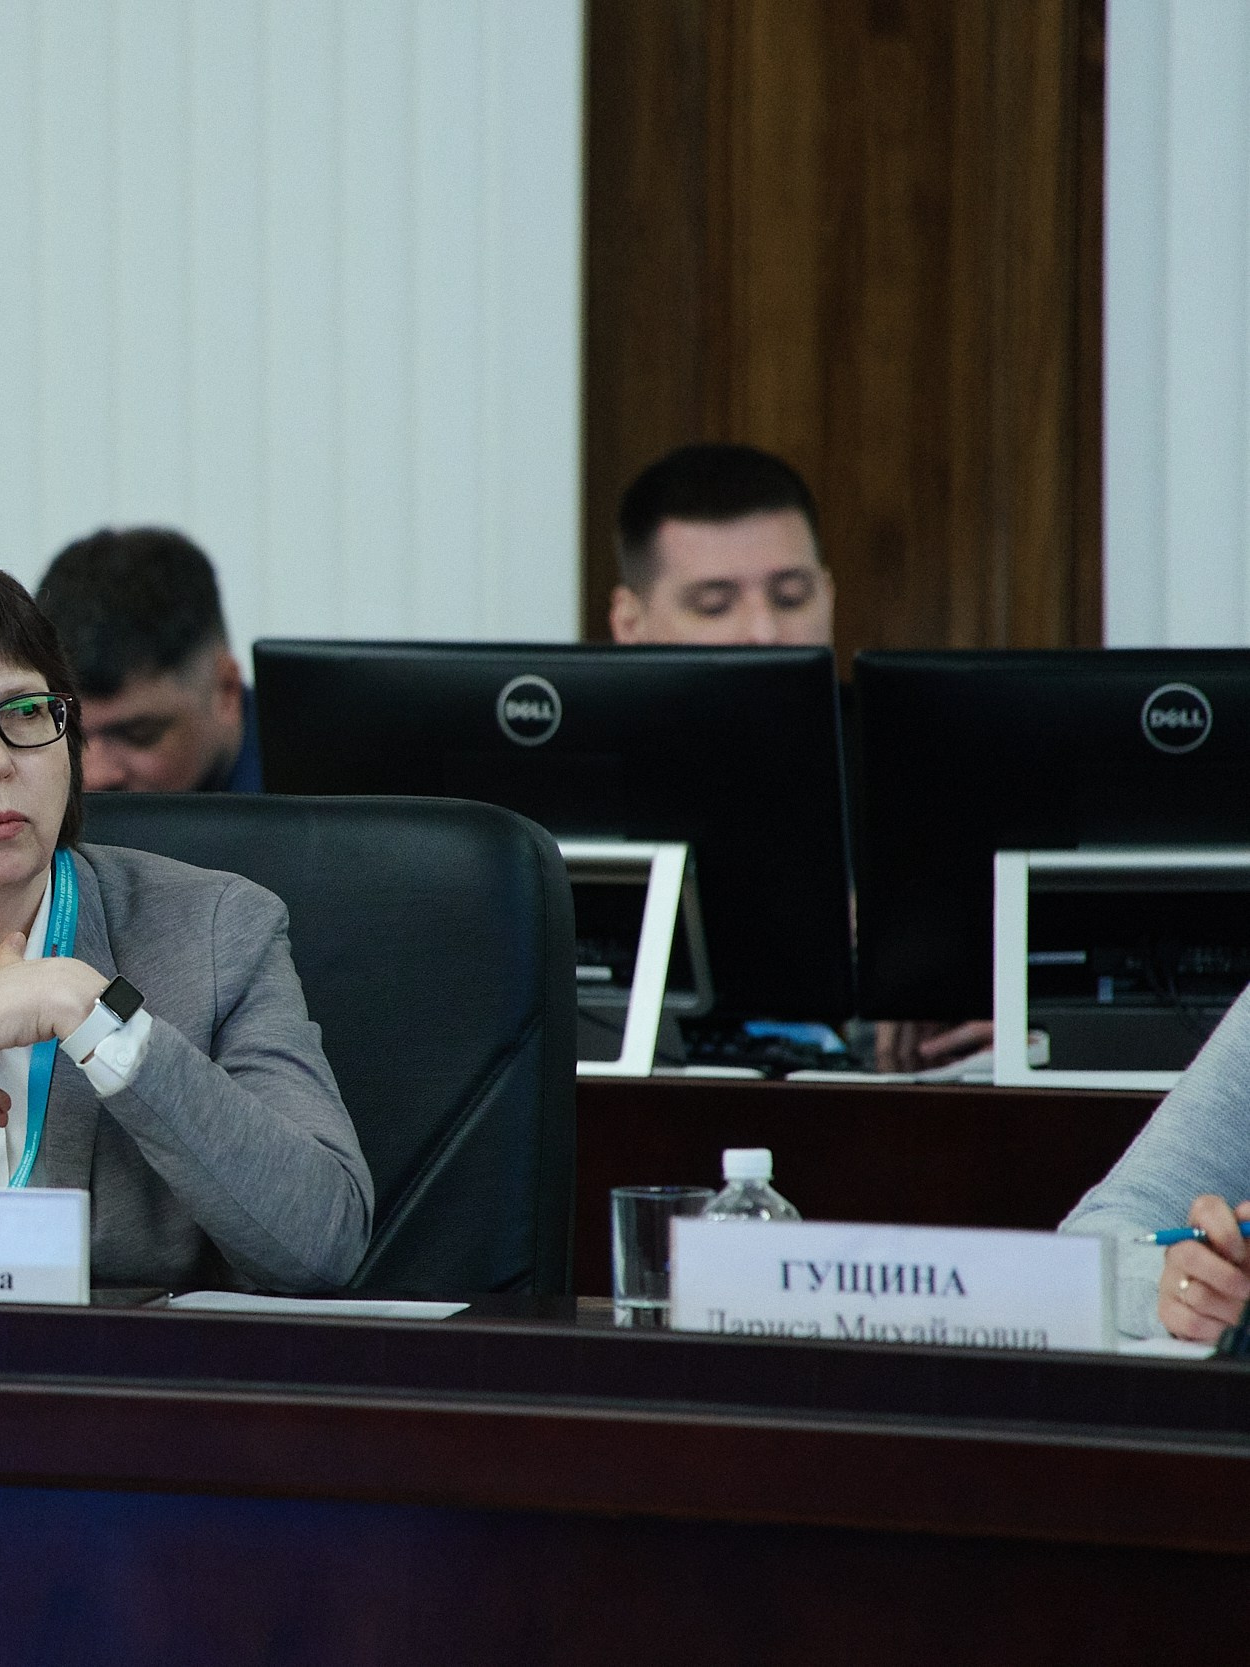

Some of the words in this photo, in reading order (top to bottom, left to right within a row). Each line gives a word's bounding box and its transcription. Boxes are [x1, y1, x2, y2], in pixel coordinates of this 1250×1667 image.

[505, 699, 554, 721] DELL
[1150, 708, 1204, 728] DELL
[781, 1259, 967, 1299] ГУЩИНА
